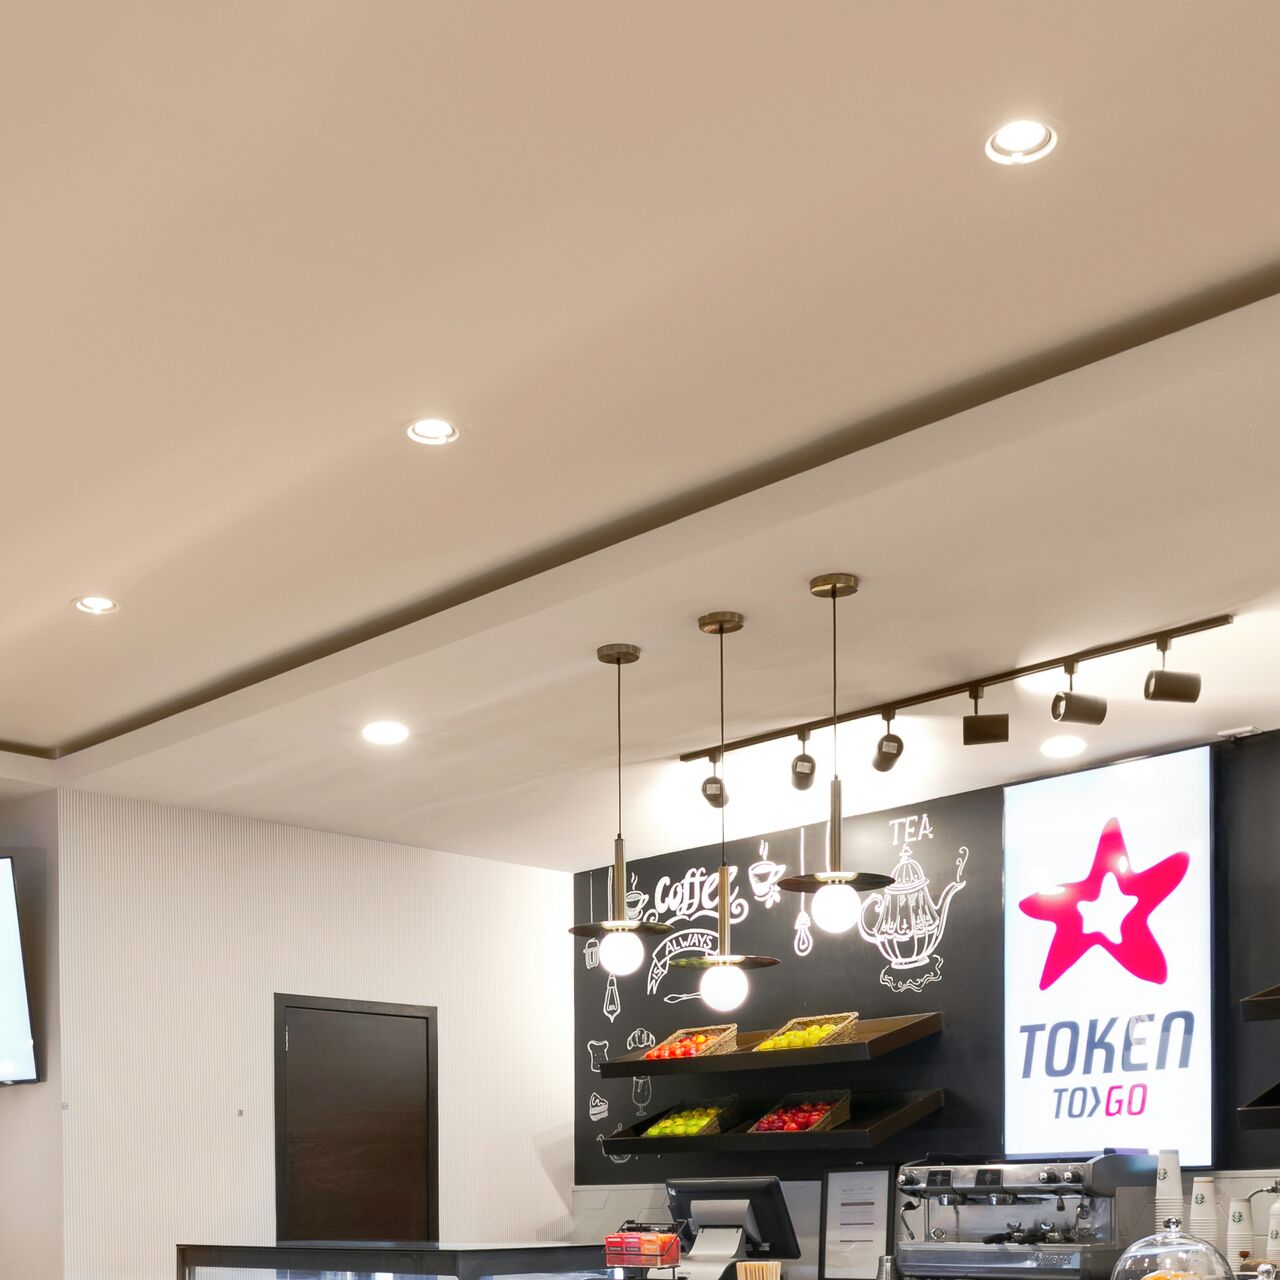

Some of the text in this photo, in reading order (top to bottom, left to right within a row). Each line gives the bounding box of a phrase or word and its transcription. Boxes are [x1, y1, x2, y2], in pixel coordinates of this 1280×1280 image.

[888, 813, 934, 846] TEA
[665, 933, 713, 956] ALWAYS
[1019, 1010, 1195, 1079] TOKEN
